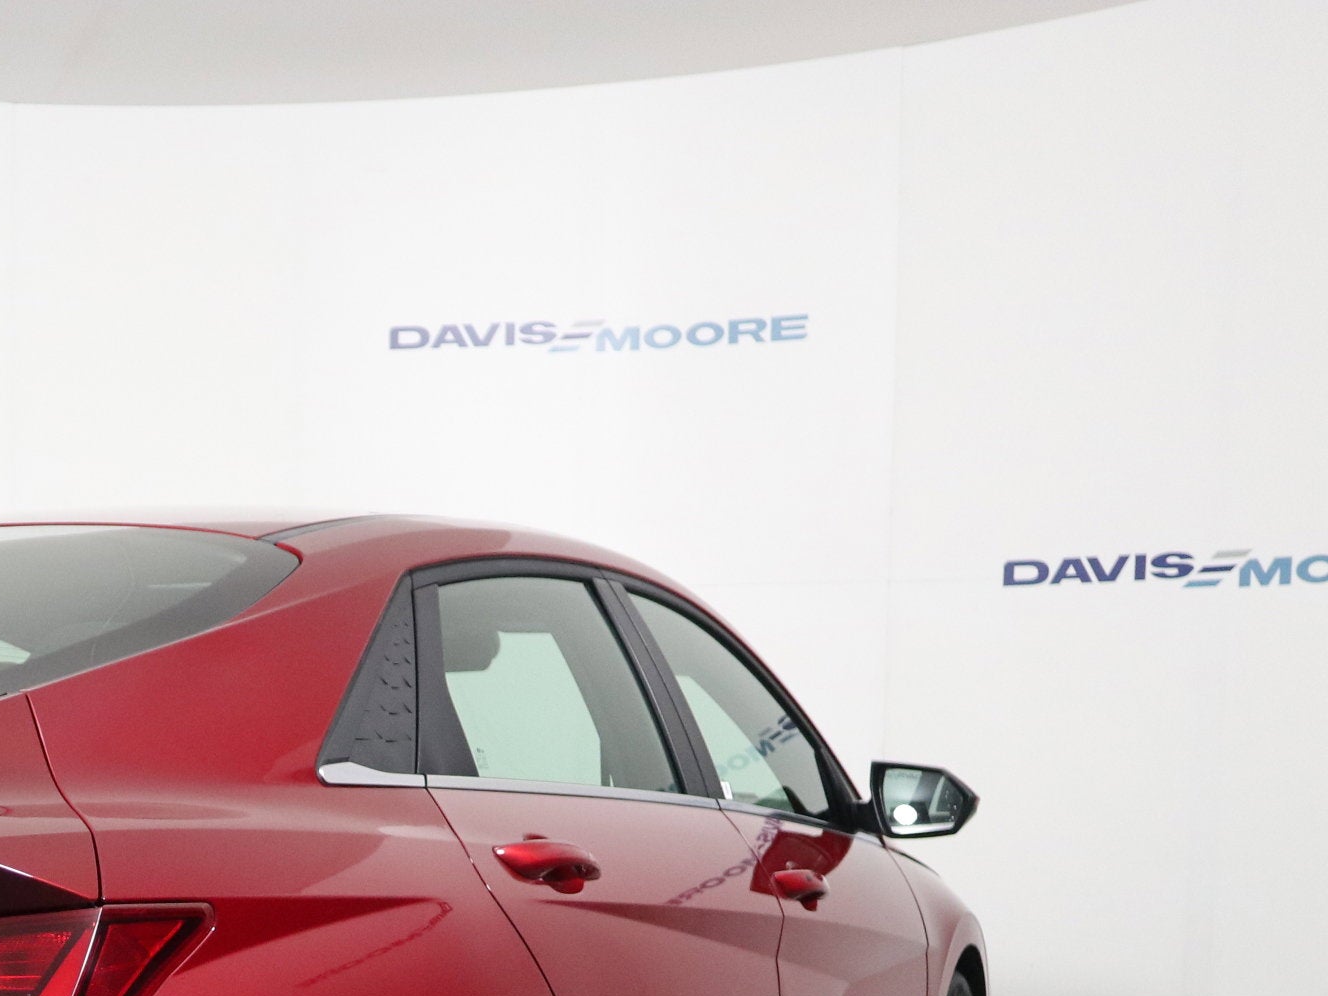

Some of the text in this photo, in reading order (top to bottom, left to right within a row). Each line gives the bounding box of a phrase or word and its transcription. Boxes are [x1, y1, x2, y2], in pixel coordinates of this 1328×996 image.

[388, 313, 809, 352] DAVIS MOORE
[1002, 550, 1195, 588] DAVIS
